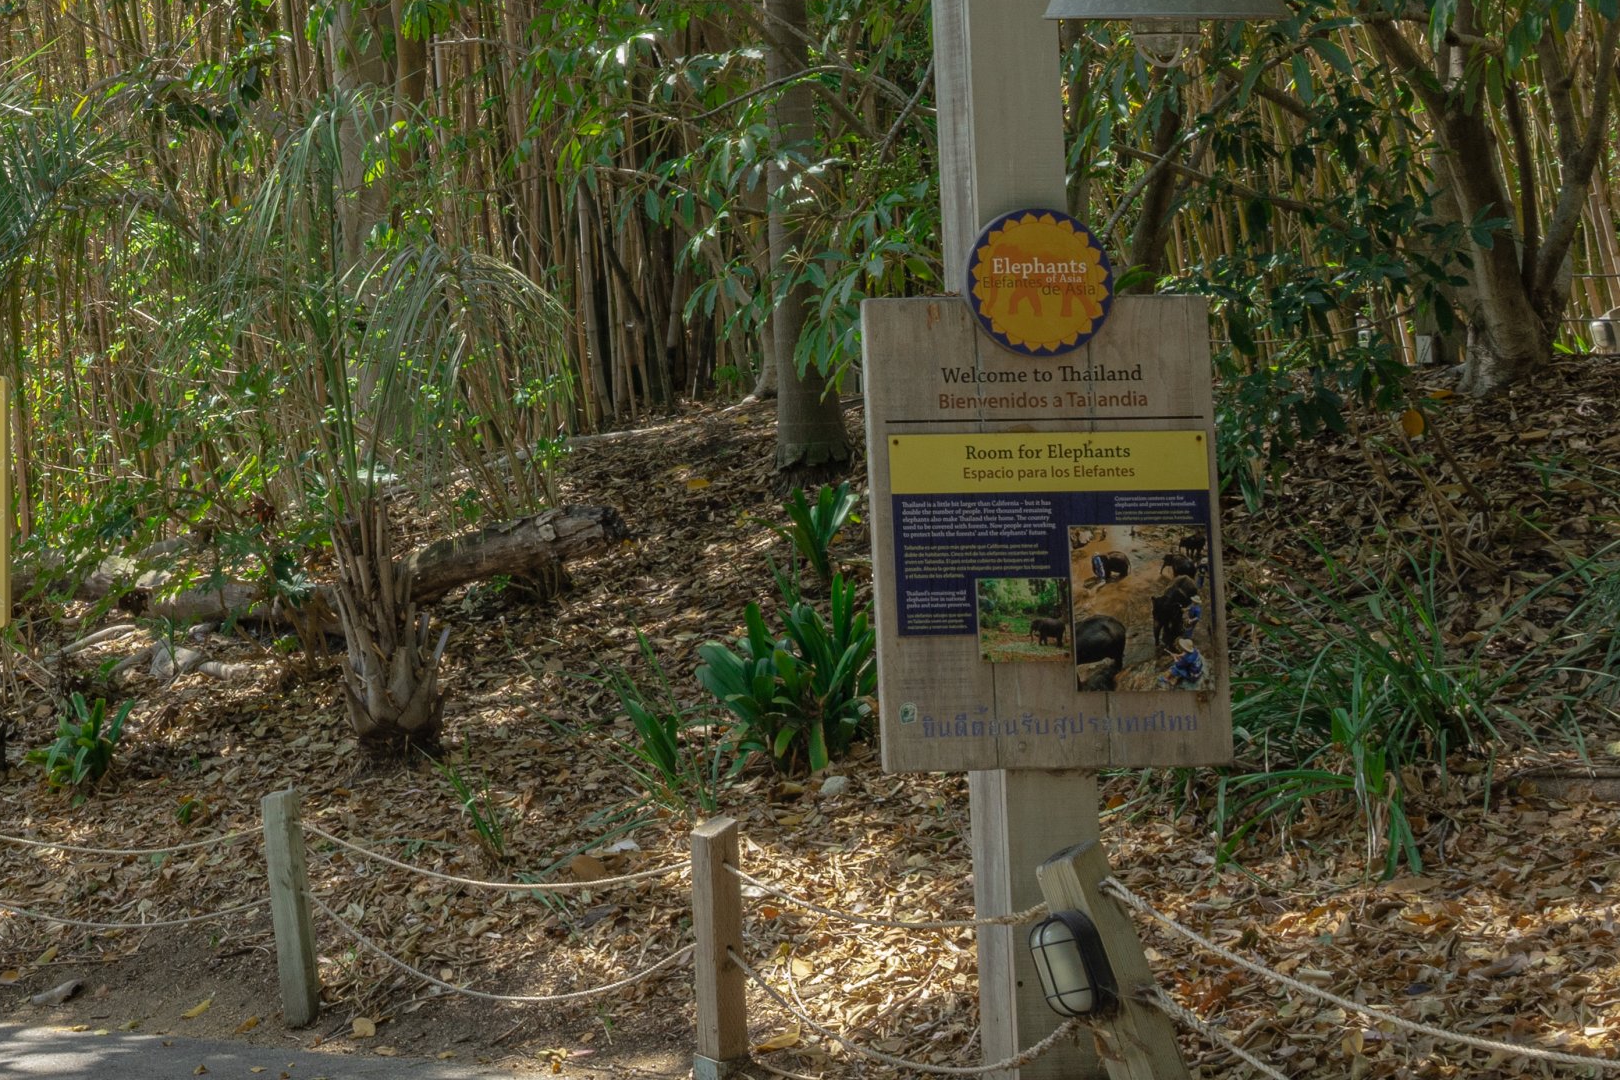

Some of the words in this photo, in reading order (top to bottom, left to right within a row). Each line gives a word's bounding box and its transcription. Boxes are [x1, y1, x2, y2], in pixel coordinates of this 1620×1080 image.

[992, 257, 1088, 279] Elephants
[983, 276, 1042, 288] Elefantes
[1046, 273, 1057, 283] of
[1060, 273, 1082, 283] Asia
[1042, 284, 1060, 295] de
[1066, 282, 1096, 295] Asia
[940, 366, 1028, 383] Welcome
[1034, 367, 1053, 382] to
[1058, 364, 1143, 382] Thailand
[939, 392, 1048, 409] Bienvenidos
[1053, 396, 1063, 408] a
[1066, 391, 1148, 408] Tailandia
[965, 445, 1013, 460] Room
[1018, 444, 1043, 459] for
[1047, 443, 1131, 462] Elephants
[963, 466, 1014, 482] Espacio
[1018, 468, 1047, 481] para
[1051, 466, 1070, 478] los
[1074, 465, 1135, 478] Elefantes
[960, 500, 976, 508] larger
[962, 508, 982, 516] people.
[1023, 507, 1052, 515] remaining
[902, 516, 929, 524] elephants
